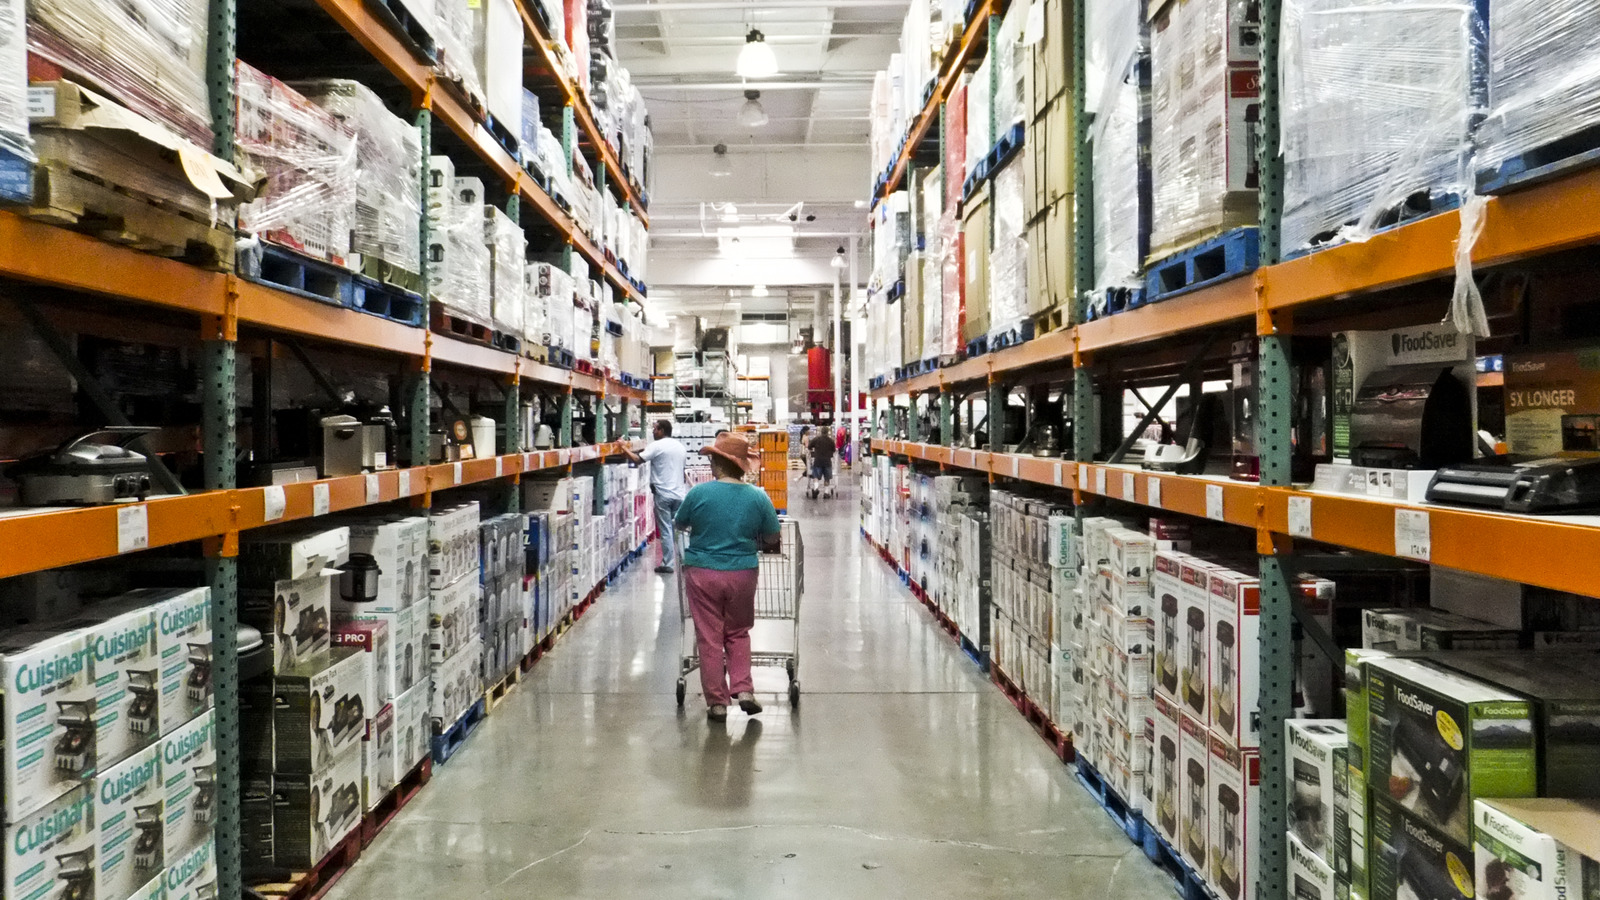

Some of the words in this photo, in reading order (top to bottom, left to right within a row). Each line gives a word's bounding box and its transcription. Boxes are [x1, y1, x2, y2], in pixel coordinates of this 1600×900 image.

[1401, 330, 1458, 352] FoodSaver
[1527, 389, 1575, 407] LONGER
[1059, 522, 1067, 565] Cuisinart
[161, 599, 211, 636] Cuisinart
[94, 621, 157, 663] Cuisinart
[344, 633, 366, 643] PRO
[15, 643, 95, 695] Cuisinart
[1397, 687, 1434, 717] FoodSaver
[164, 715, 216, 764] Cuisinart
[1295, 730, 1326, 762] FoodSaver
[100, 751, 163, 805] Cuisinart
[15, 791, 96, 857] Cuisinart
[1405, 818, 1444, 853] FoodSaver
[1489, 816, 1525, 844] FoodSaver
[1296, 847, 1329, 885] FoodSaver
